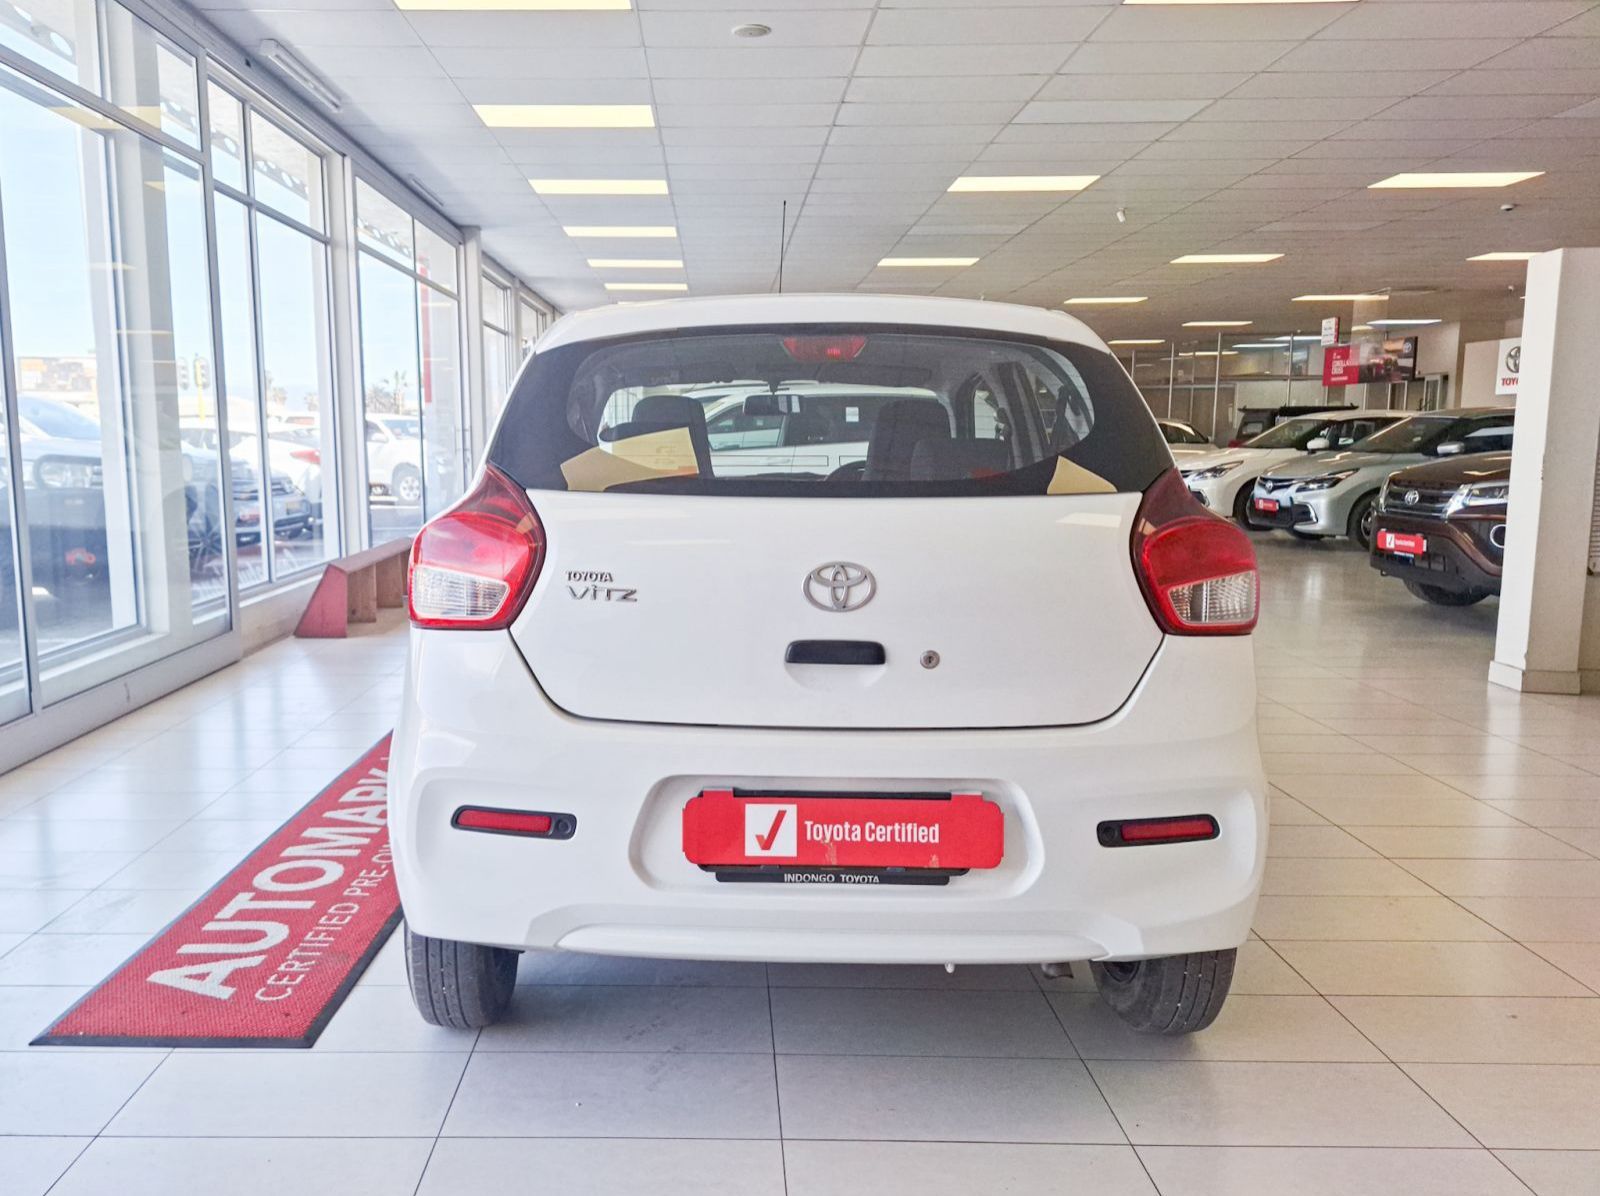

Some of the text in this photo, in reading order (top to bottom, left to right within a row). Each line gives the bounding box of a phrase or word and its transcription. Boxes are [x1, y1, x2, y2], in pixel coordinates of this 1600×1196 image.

[566, 570, 614, 583] TOYOTA
[804, 820, 940, 843] Toyota Certified
[783, 873, 880, 884] INDONGO TOYOTA
[255, 902, 360, 1002] CERTIFIED
